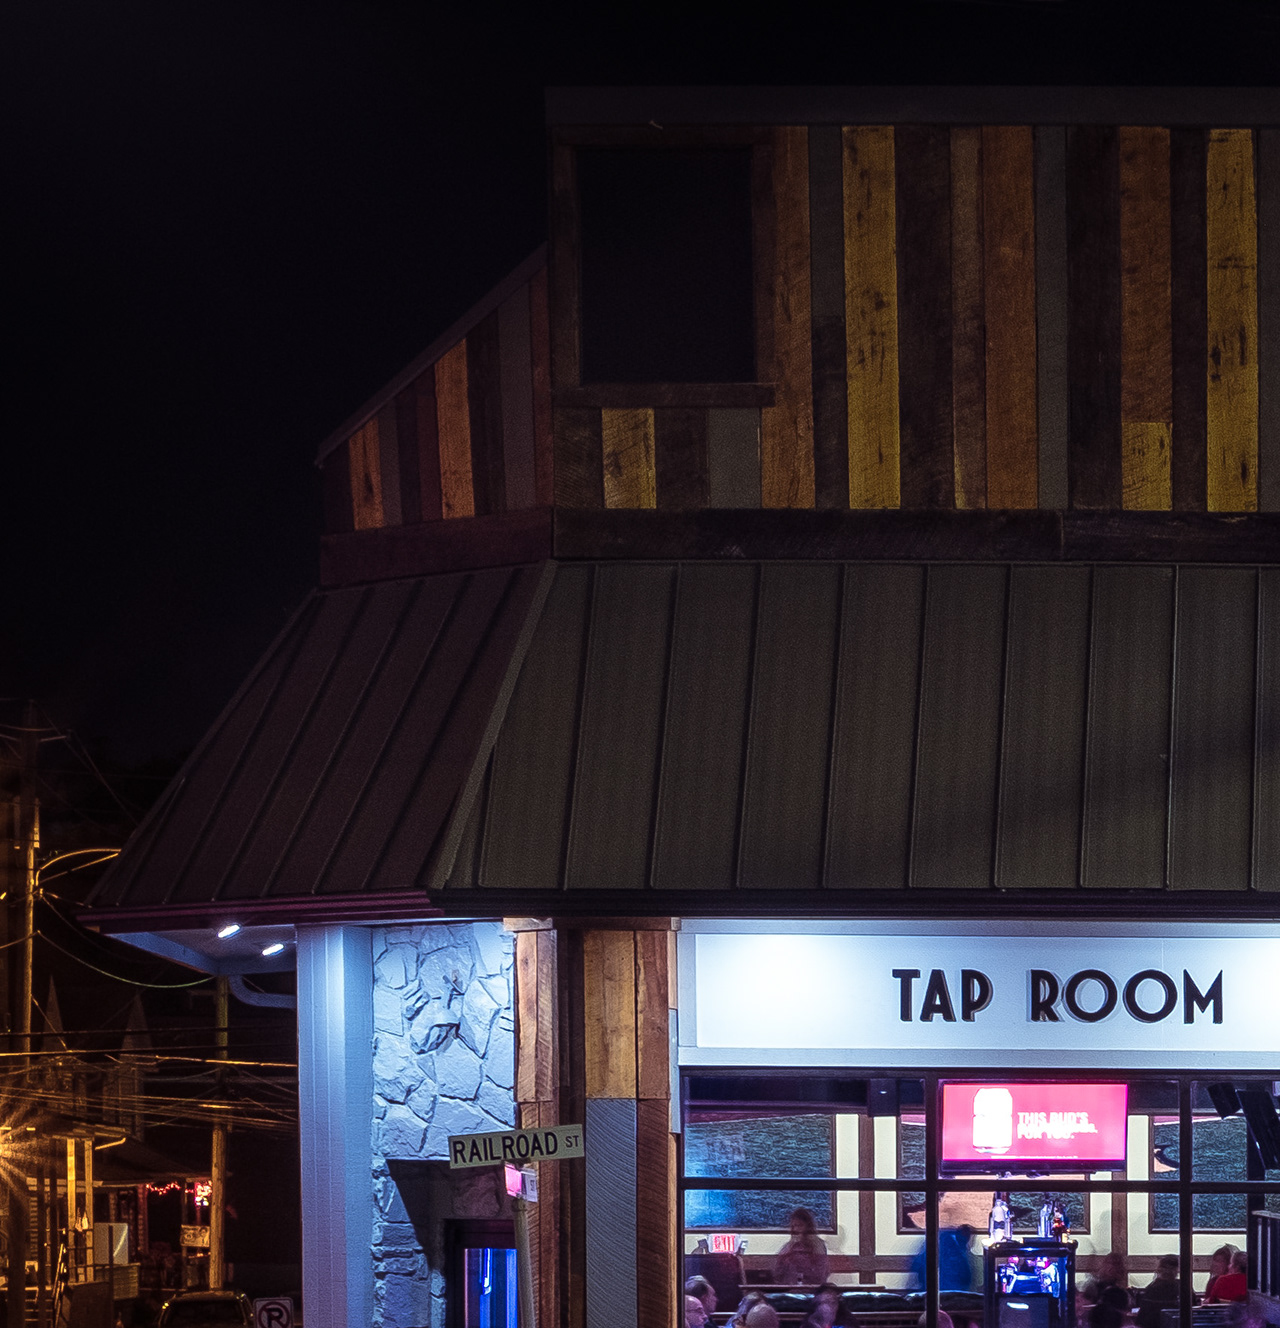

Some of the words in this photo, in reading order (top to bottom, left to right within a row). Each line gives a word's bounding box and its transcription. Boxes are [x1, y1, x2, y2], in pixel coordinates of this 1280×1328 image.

[891, 968, 994, 1023] TAP
[1029, 968, 1224, 1025] ROOM
[1017, 1112, 1047, 1125] THIS
[452, 1132, 558, 1164] RAILROAD
[565, 1135, 579, 1148] ST
